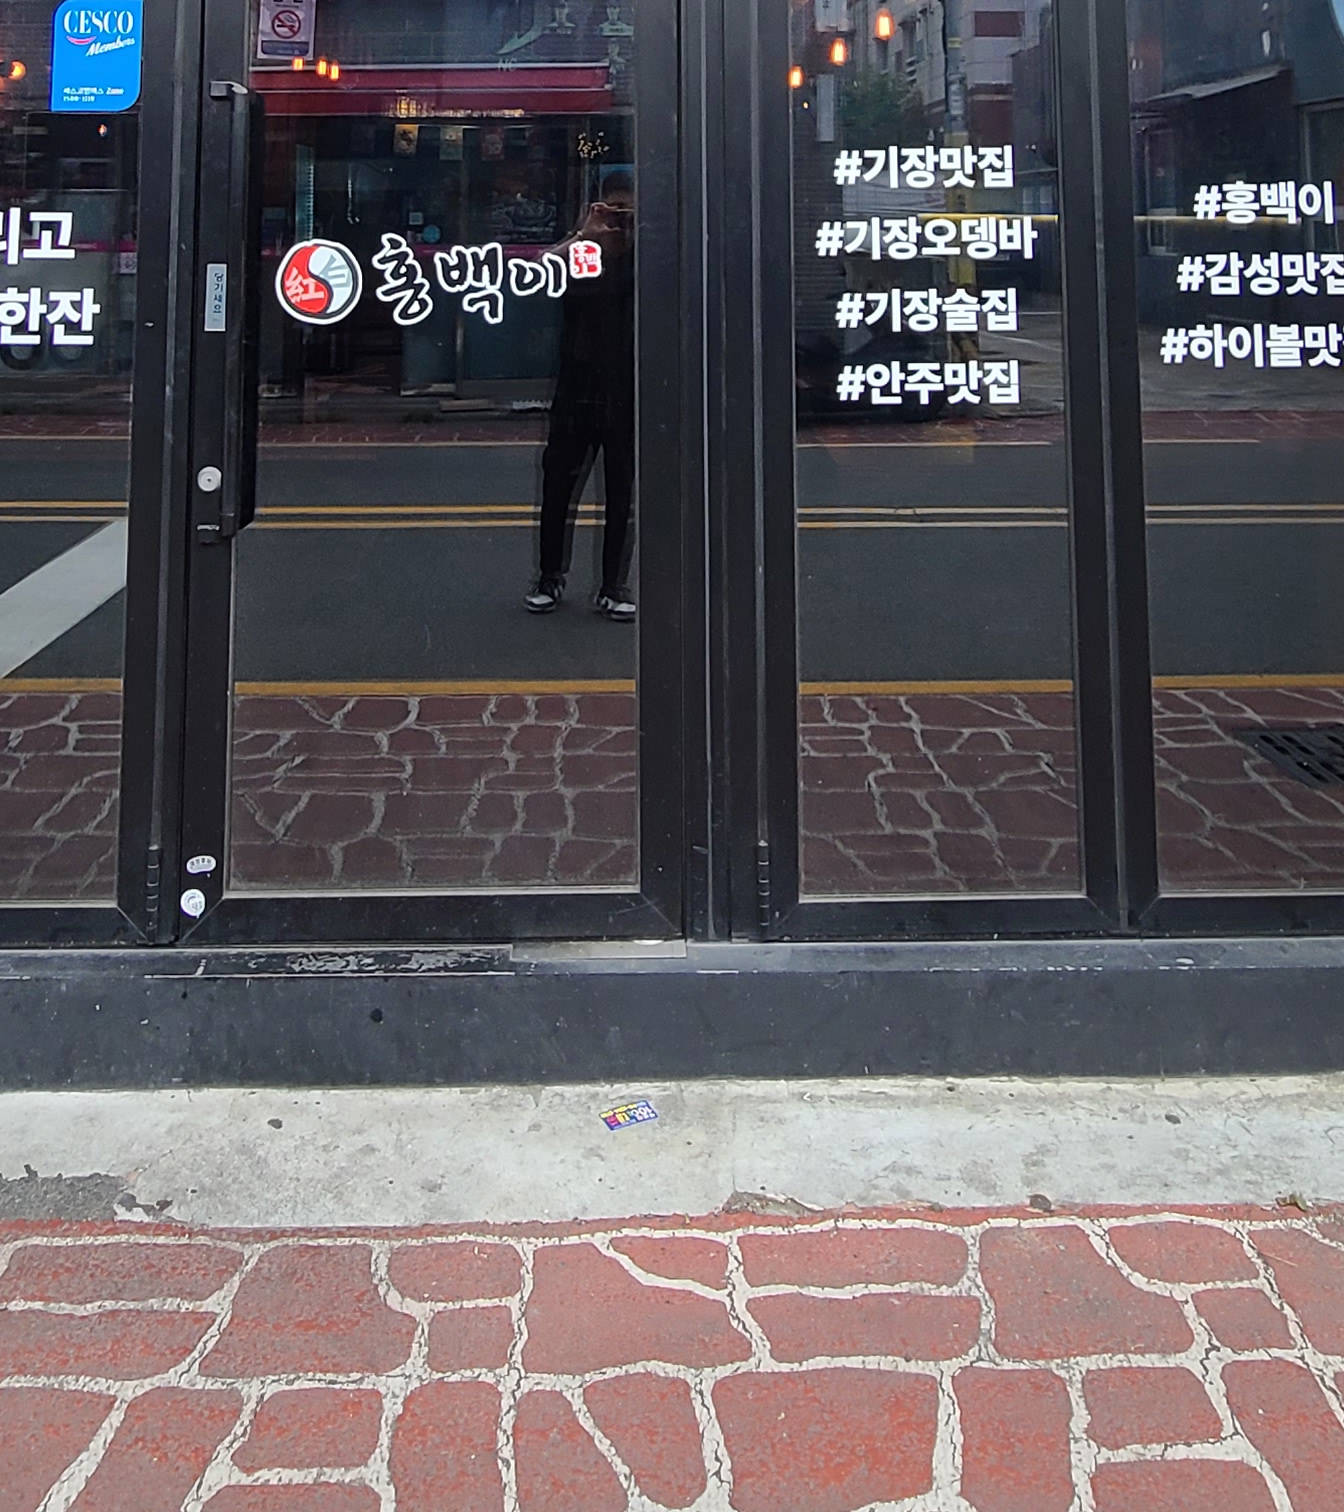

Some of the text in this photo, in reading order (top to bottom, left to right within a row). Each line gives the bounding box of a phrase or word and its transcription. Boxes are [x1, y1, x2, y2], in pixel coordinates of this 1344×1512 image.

[63, 9, 134, 34] CESCO
[85, 35, 136, 57] Members
[833, 144, 1014, 189] #기장맛집
[1192, 180, 1335, 225] #홍백이
[815, 215, 1038, 260] #기장오뎅바
[834, 287, 1018, 332] #기장술집
[836, 359, 1021, 405] #안주맛집
